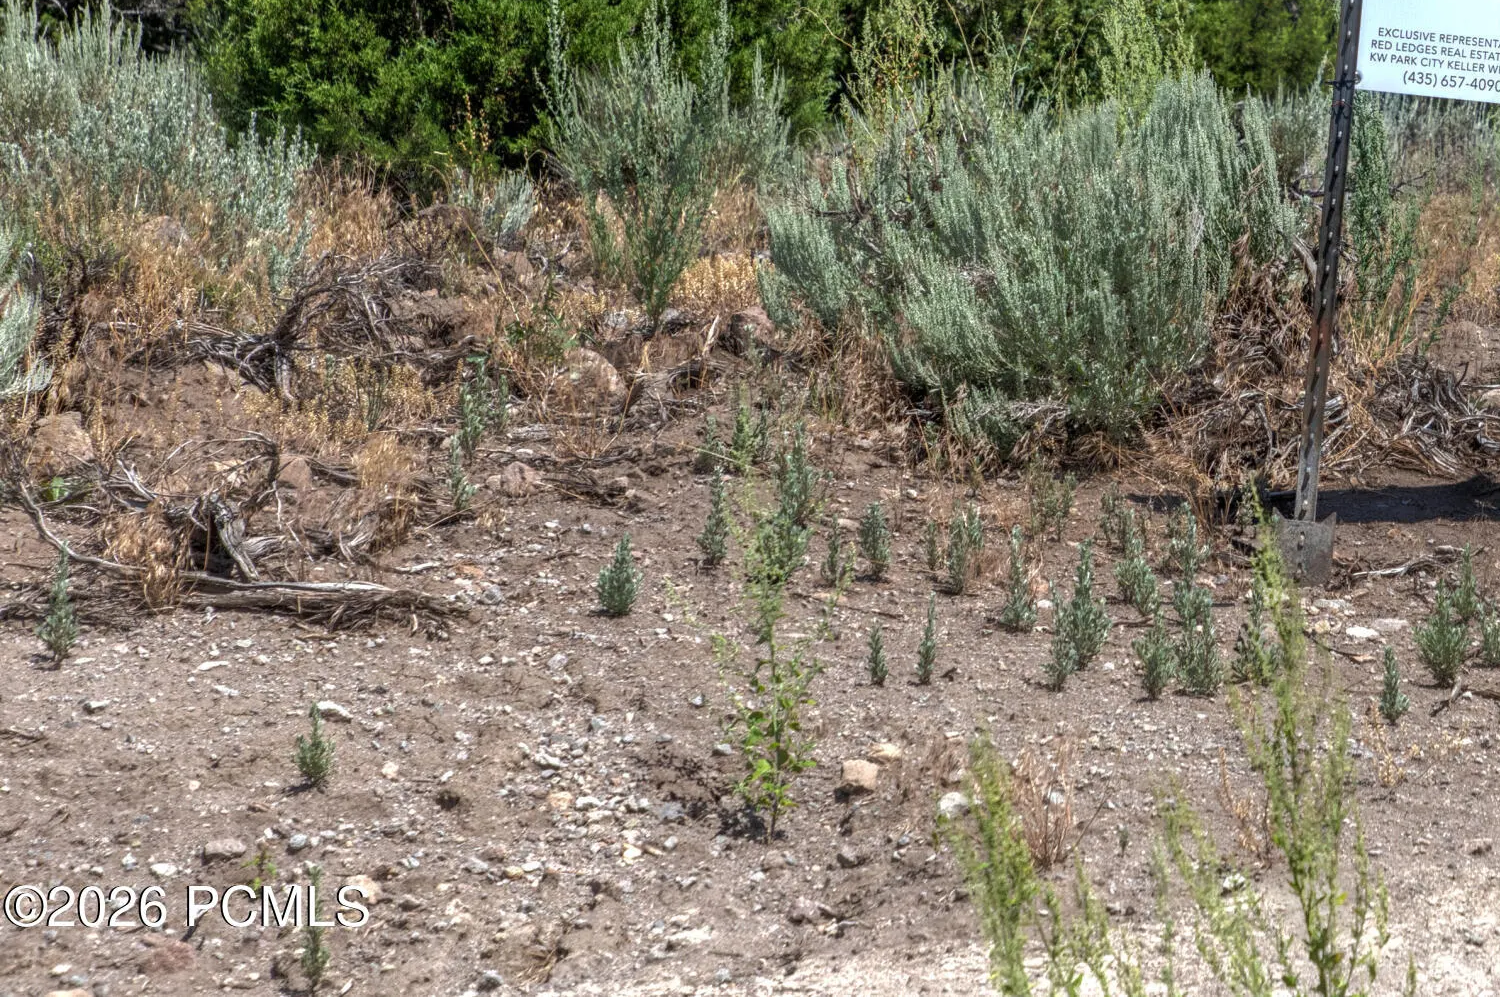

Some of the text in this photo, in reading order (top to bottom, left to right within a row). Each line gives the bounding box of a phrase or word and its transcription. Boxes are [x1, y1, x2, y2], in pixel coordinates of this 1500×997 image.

[1378, 27, 1436, 42] EXCLUSIVE
[1371, 39, 1393, 50] RED
[1396, 43, 1437, 55] LEDGES
[1441, 47, 1467, 58] REAL
[1370, 52, 1387, 63] KW
[1390, 54, 1417, 66] PARK
[1421, 57, 1445, 69] CITY
[1447, 60, 1485, 73] KELLER
[1403, 70, 1438, 88] (435)
